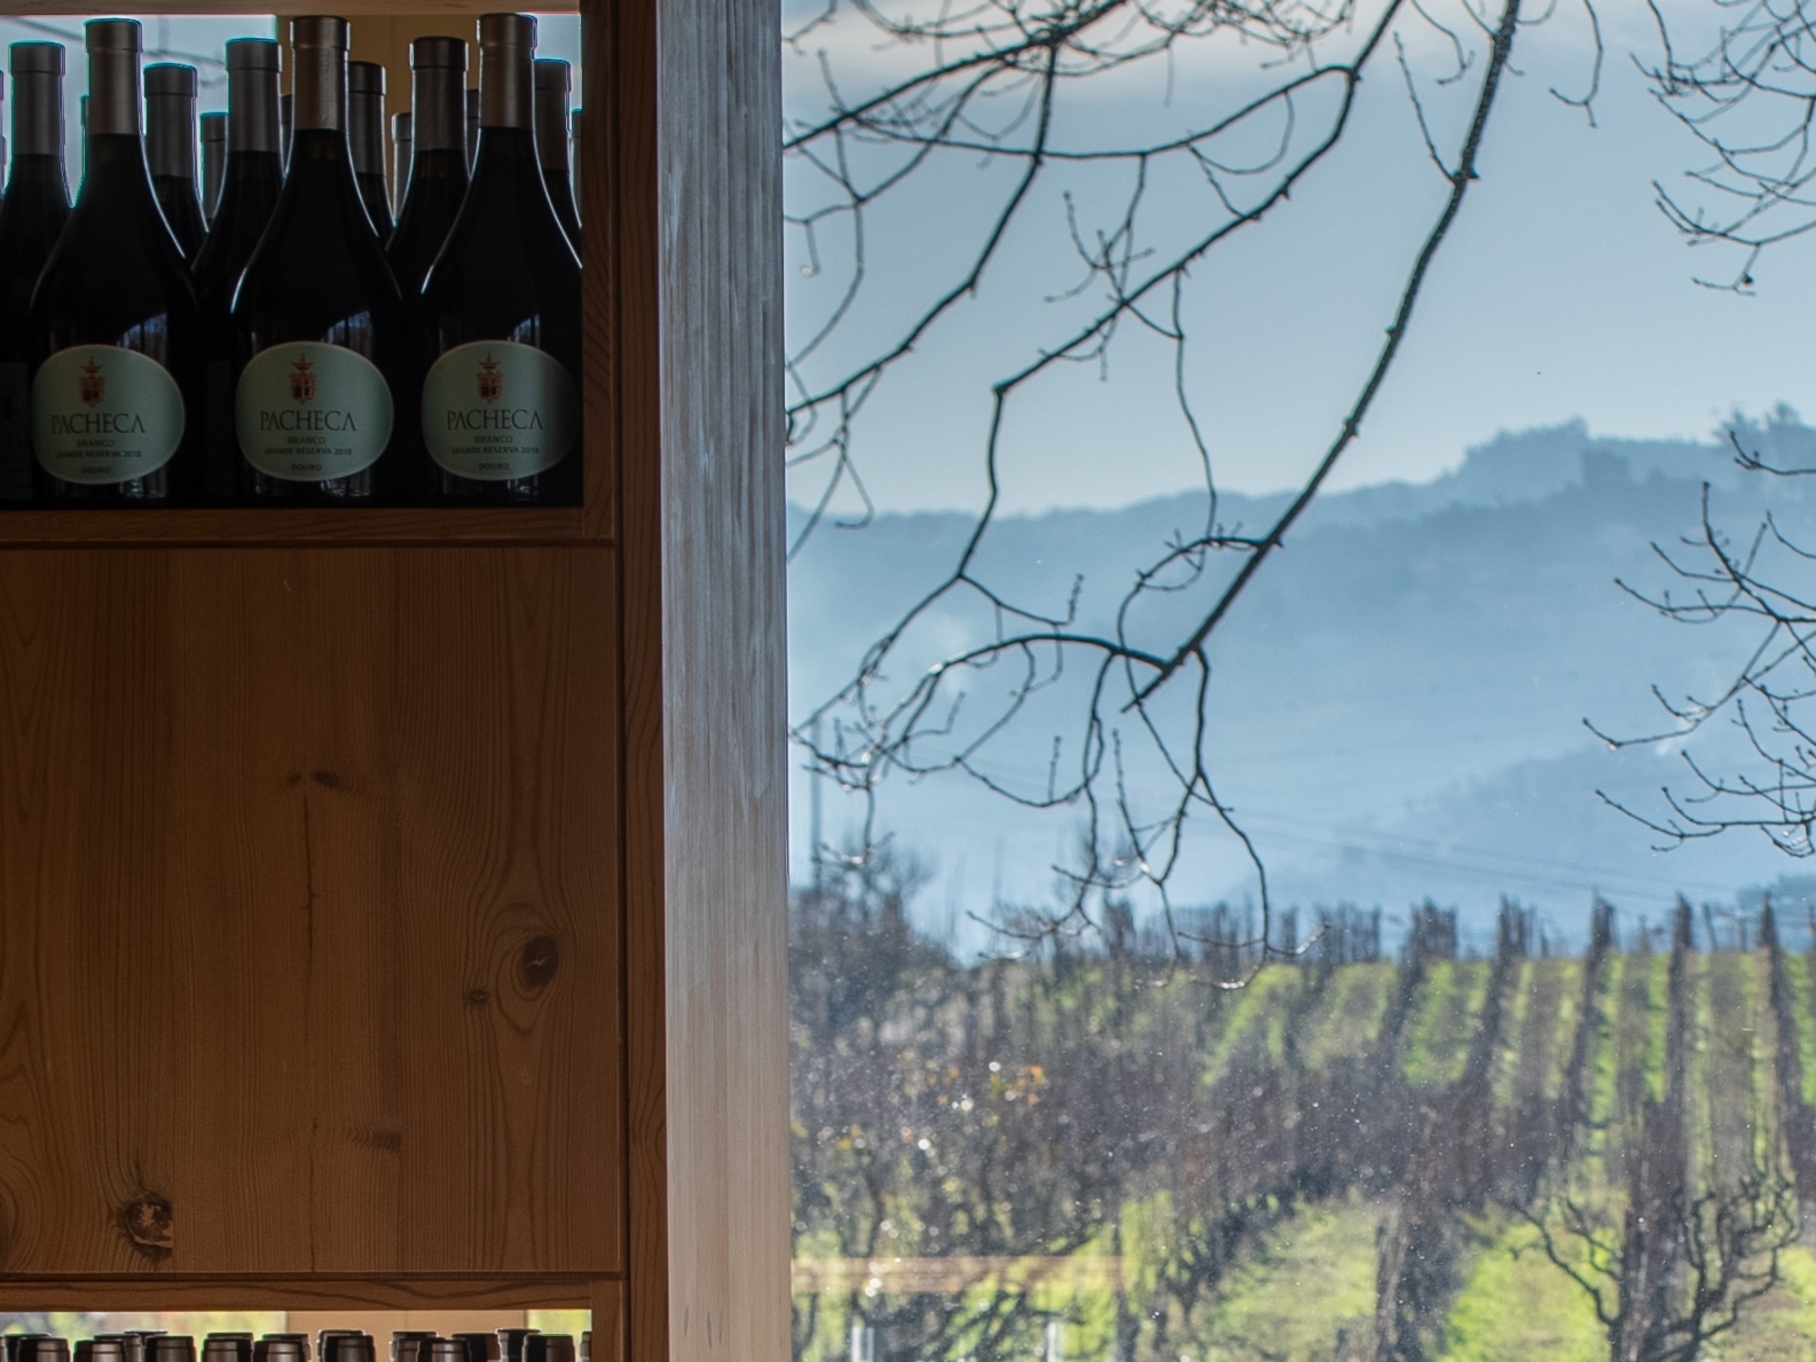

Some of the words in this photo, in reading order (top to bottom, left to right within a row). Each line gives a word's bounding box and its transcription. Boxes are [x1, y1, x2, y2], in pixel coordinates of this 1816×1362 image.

[51, 412, 146, 435] PACHECA
[259, 410, 357, 431] PACHECA
[446, 409, 544, 431] PACHECA
[287, 436, 326, 445] BRANCO
[474, 435, 513, 443] BRANCO
[483, 446, 519, 454] RESERVA
